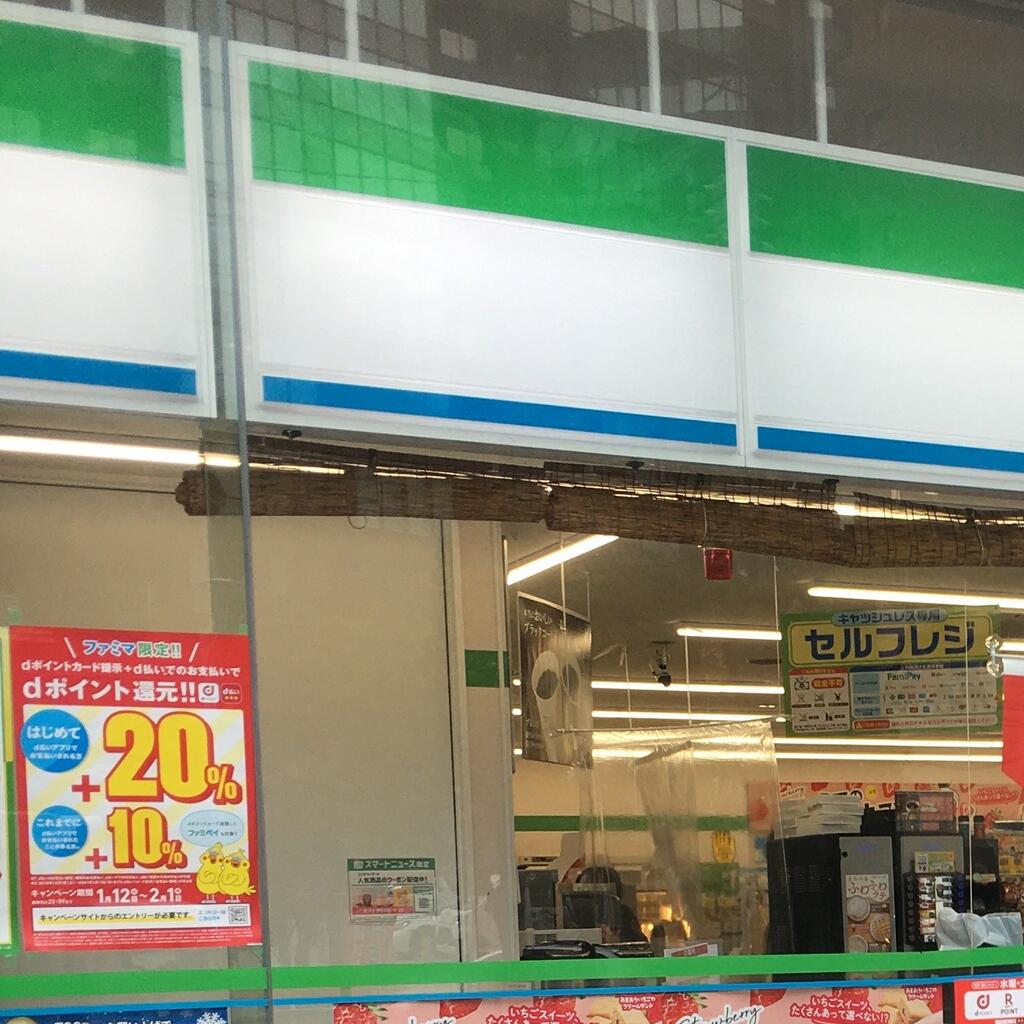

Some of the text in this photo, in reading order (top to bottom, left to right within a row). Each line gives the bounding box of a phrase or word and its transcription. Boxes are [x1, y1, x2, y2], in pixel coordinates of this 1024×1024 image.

[838, 608, 942, 625] キャッシュレス専用
[805, 621, 975, 660] セルフレジ
[27, 726, 81, 740] はじめて
[1000, 1008, 1018, 1016] POINT
